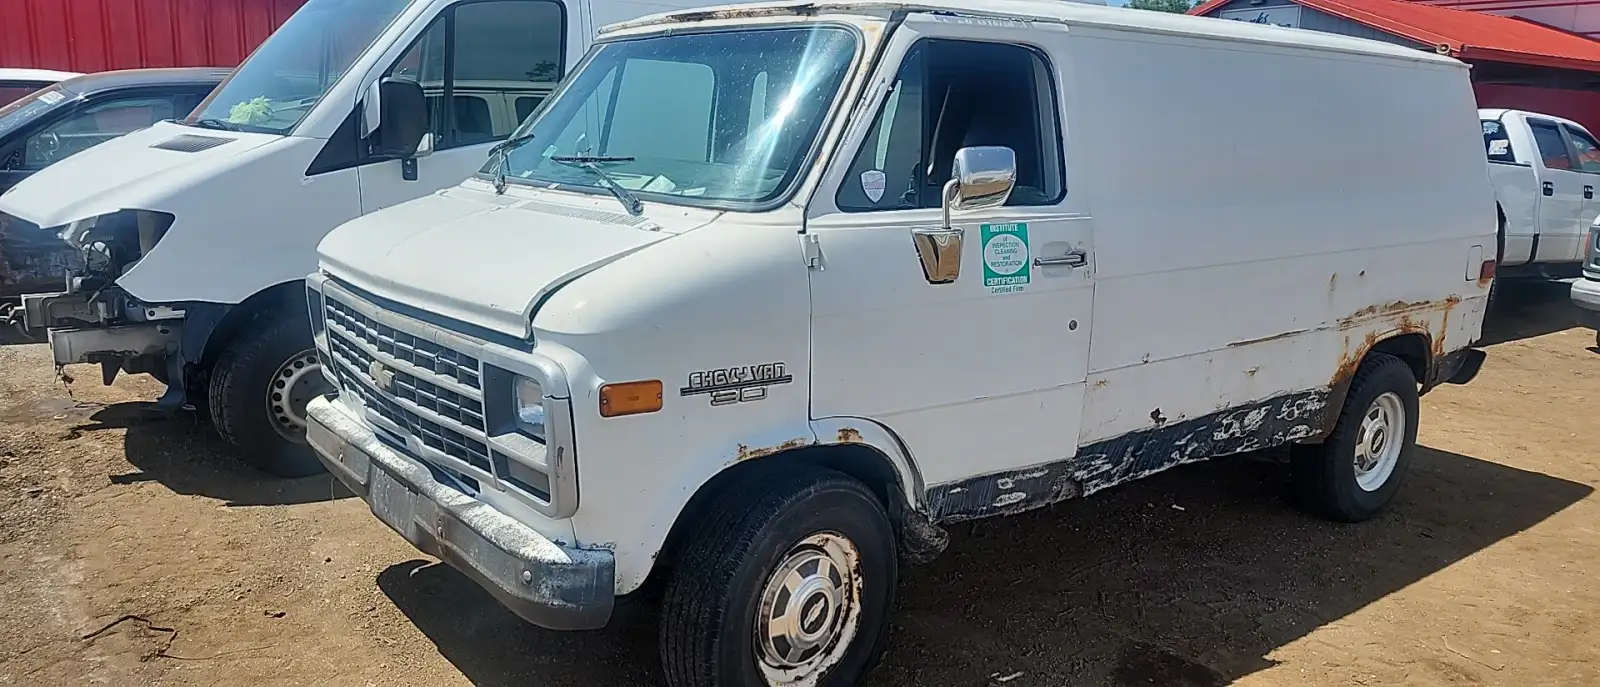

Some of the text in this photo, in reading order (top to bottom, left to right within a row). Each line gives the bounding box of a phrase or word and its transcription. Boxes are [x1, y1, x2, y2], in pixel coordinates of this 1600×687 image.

[990, 224, 1018, 232] INSTITUTE
[991, 260, 1022, 268] RESTORATION
[986, 276, 1028, 286] CERTIFICATION
[992, 286, 1011, 294] Certified
[689, 366, 748, 388] CHEVY
[711, 386, 768, 406] 30
